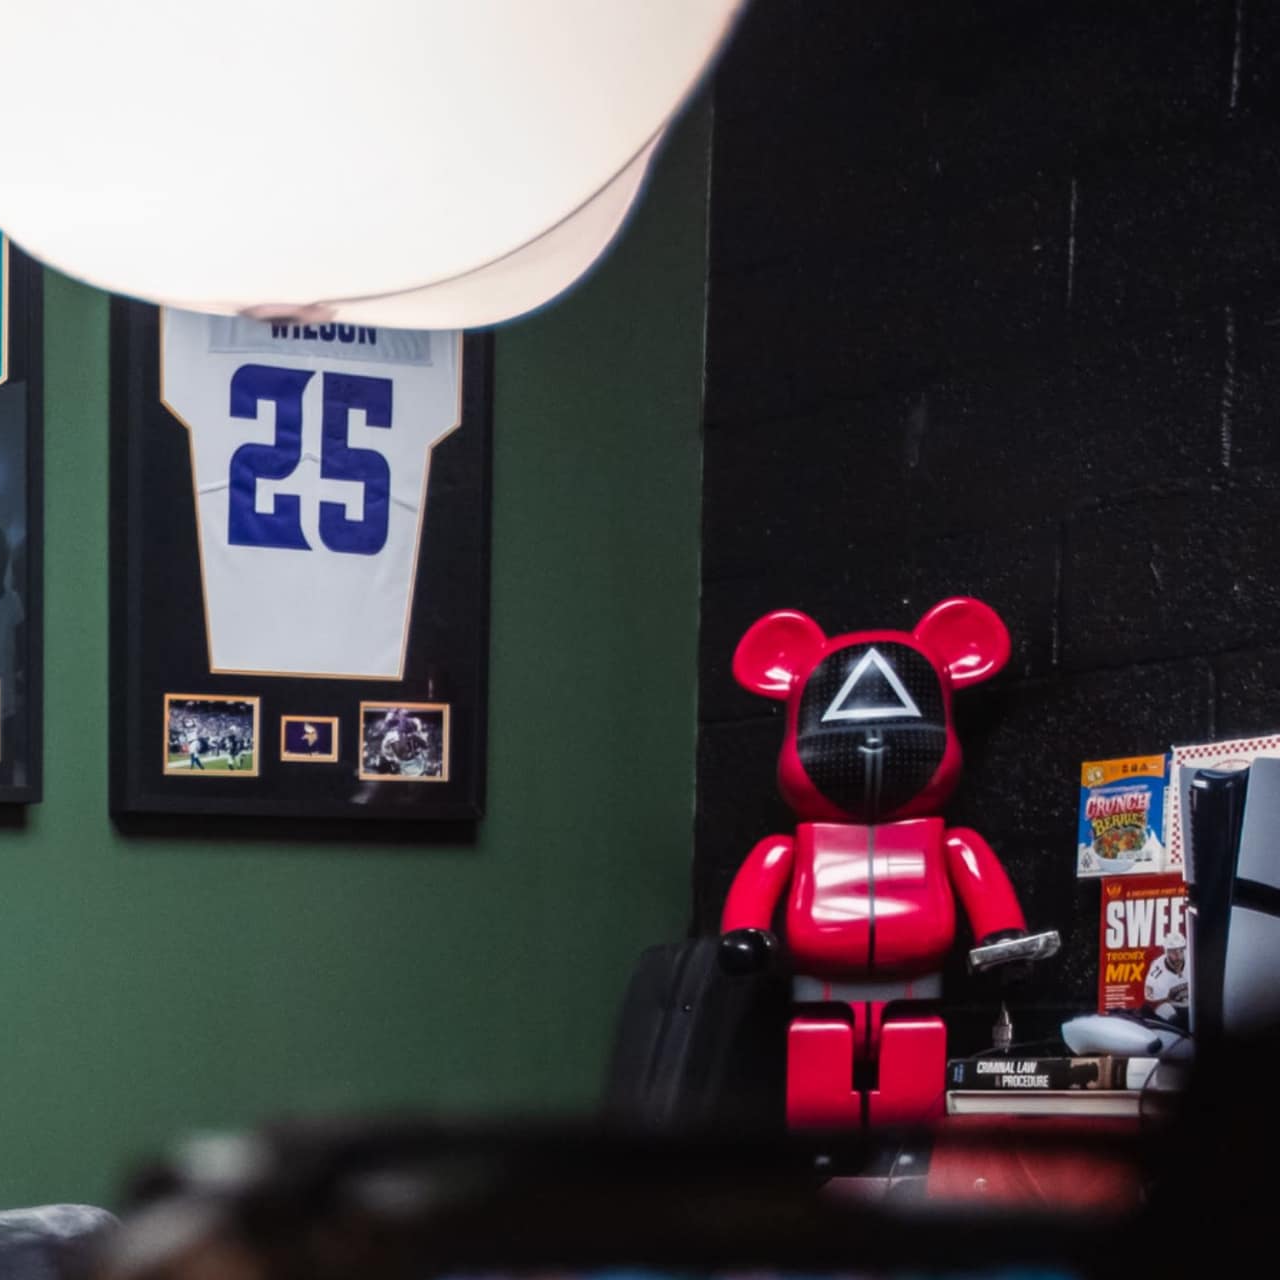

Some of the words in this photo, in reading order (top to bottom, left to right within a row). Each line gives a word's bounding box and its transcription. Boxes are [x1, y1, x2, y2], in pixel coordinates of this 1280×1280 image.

[227, 362, 394, 556] 25
[1085, 791, 1152, 821] CRUNCH
[1105, 896, 1185, 950] SWEE
[1106, 962, 1146, 983] MIX
[976, 1061, 1016, 1075] CRIMINAL
[1017, 1060, 1038, 1074] LAW
[1002, 1075, 1049, 1089] PROCEDURE
